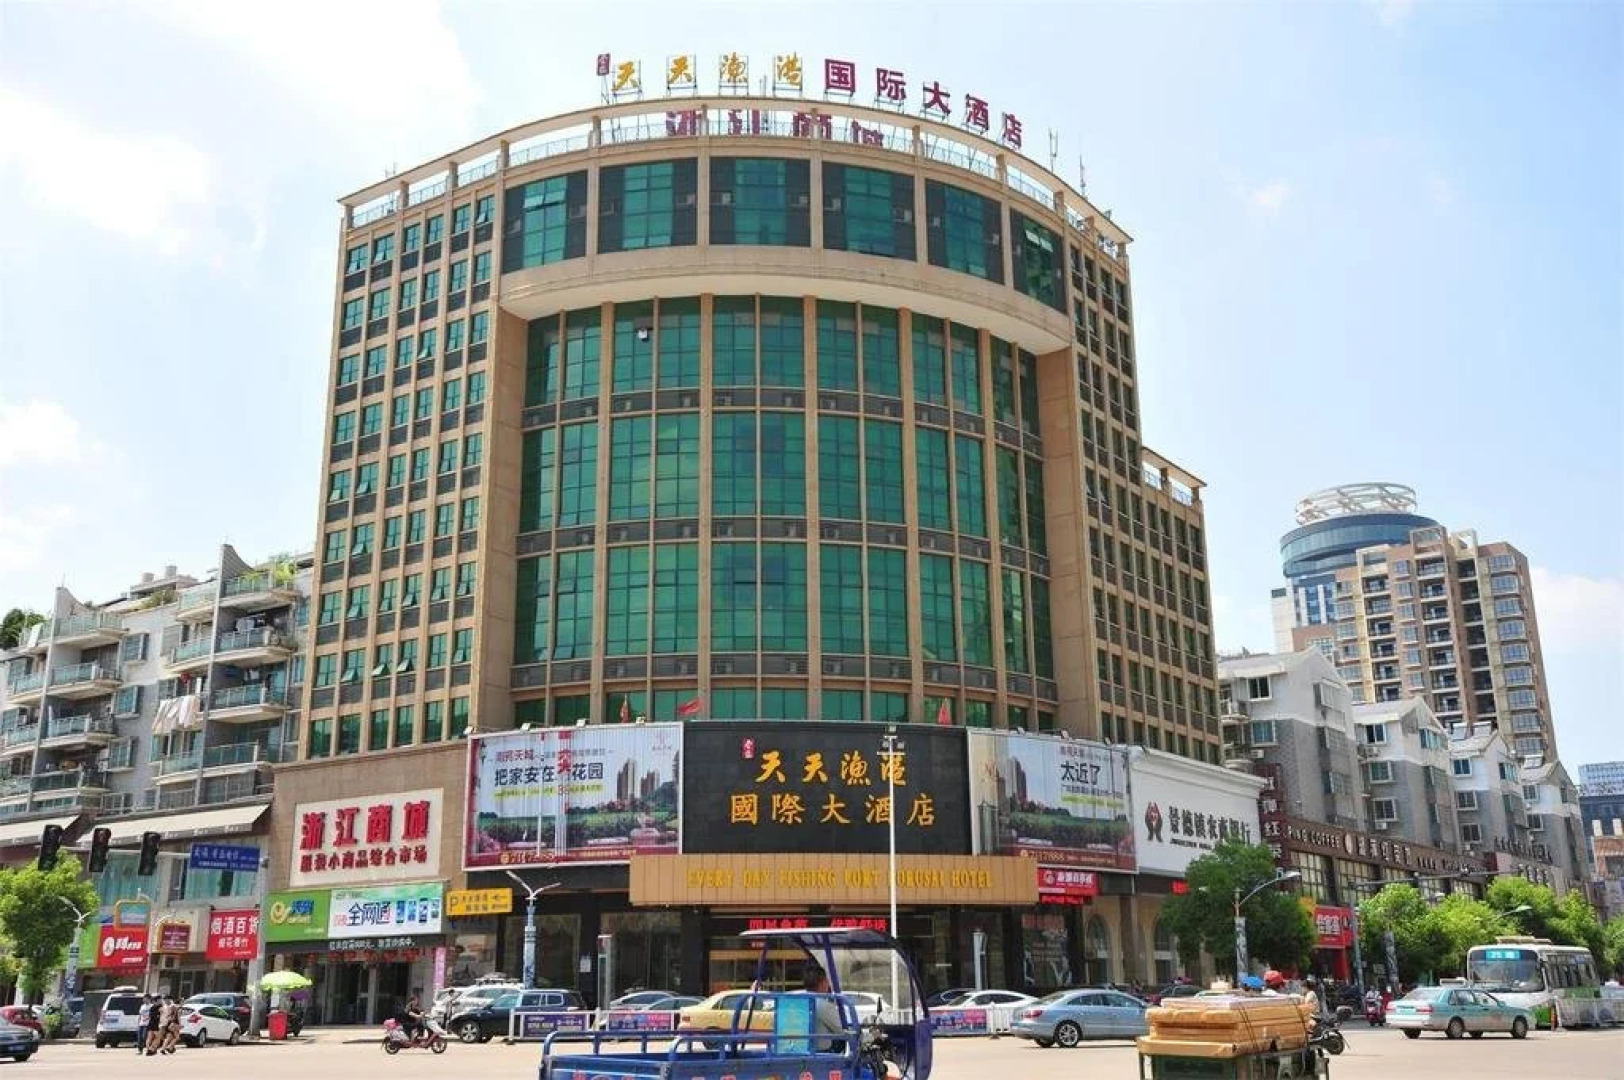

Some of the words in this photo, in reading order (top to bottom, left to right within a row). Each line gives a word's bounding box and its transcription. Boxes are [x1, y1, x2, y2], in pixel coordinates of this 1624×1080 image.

[495, 762, 603, 787] 把家安在花园
[1061, 760, 1101, 785] 太近了
[300, 801, 431, 850] 浙江商城
[687, 868, 734, 889] EVERY
[743, 868, 771, 889] DAY
[951, 868, 992, 889] HOTEL
[349, 901, 391, 926] 全网通
